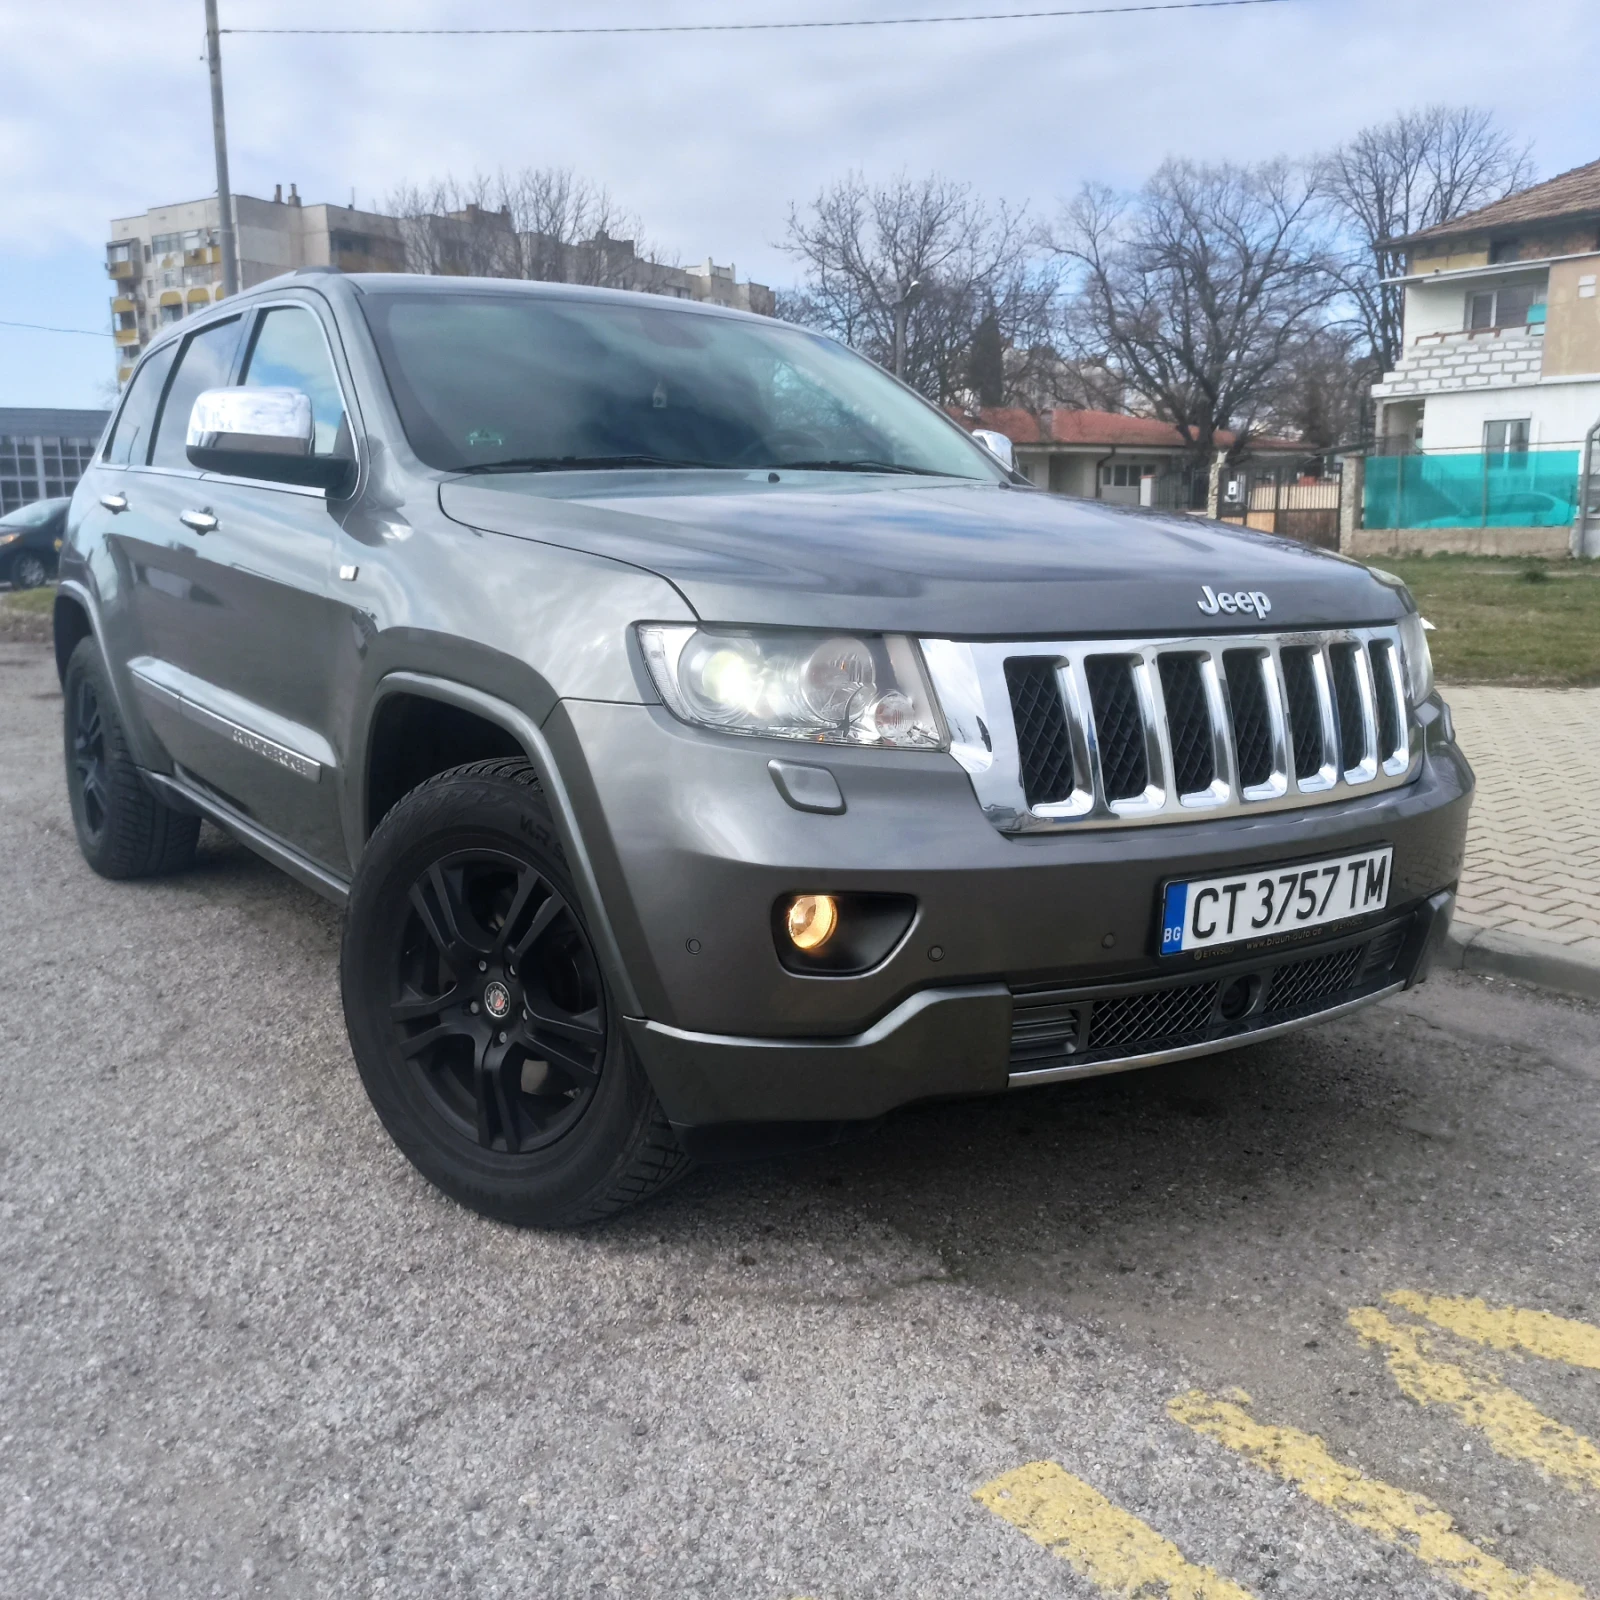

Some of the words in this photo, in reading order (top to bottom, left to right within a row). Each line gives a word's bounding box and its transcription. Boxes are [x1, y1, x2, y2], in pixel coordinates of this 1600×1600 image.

[1197, 585, 1272, 620] Jeep
[1191, 882, 1246, 940] CT
[1251, 864, 1341, 929] 3757
[1347, 854, 1388, 910] TM
[1163, 926, 1182, 943] BG
